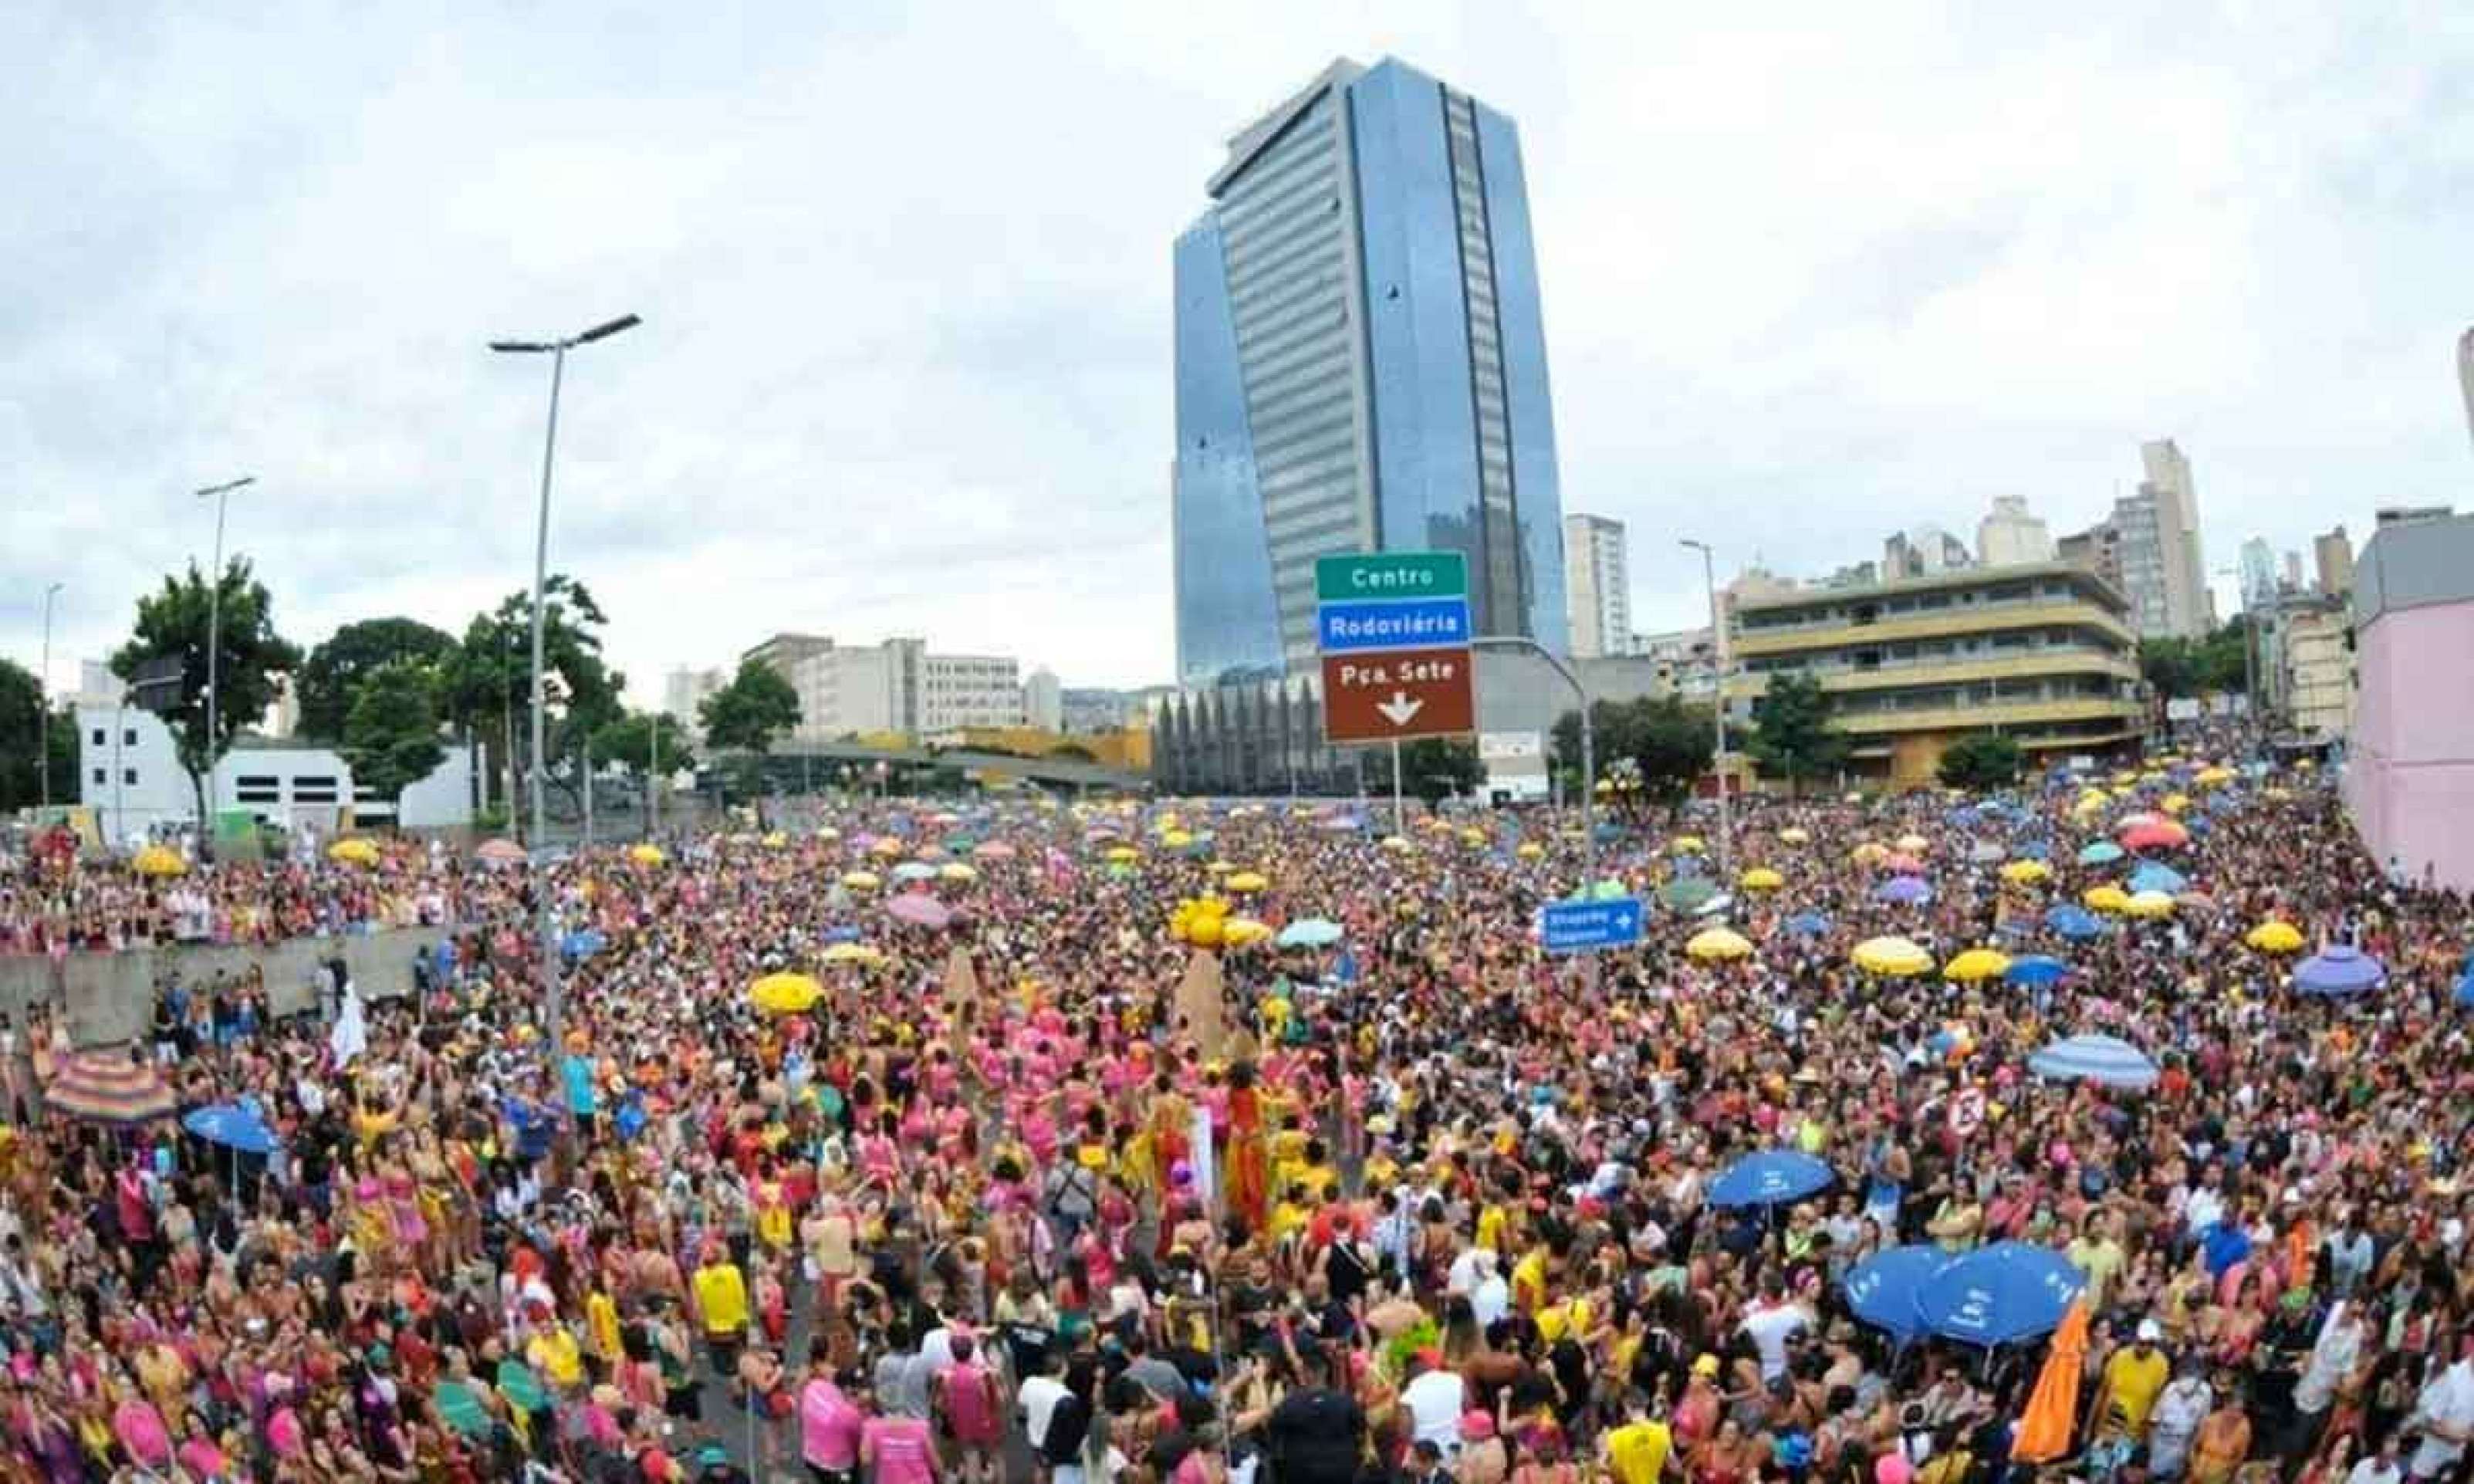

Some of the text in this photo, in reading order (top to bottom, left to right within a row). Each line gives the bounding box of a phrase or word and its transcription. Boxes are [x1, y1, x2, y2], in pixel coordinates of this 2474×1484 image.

[1352, 568, 1434, 588] Centro
[1330, 610, 1457, 637] Rodoviária
[1398, 660, 1455, 681] Sete
